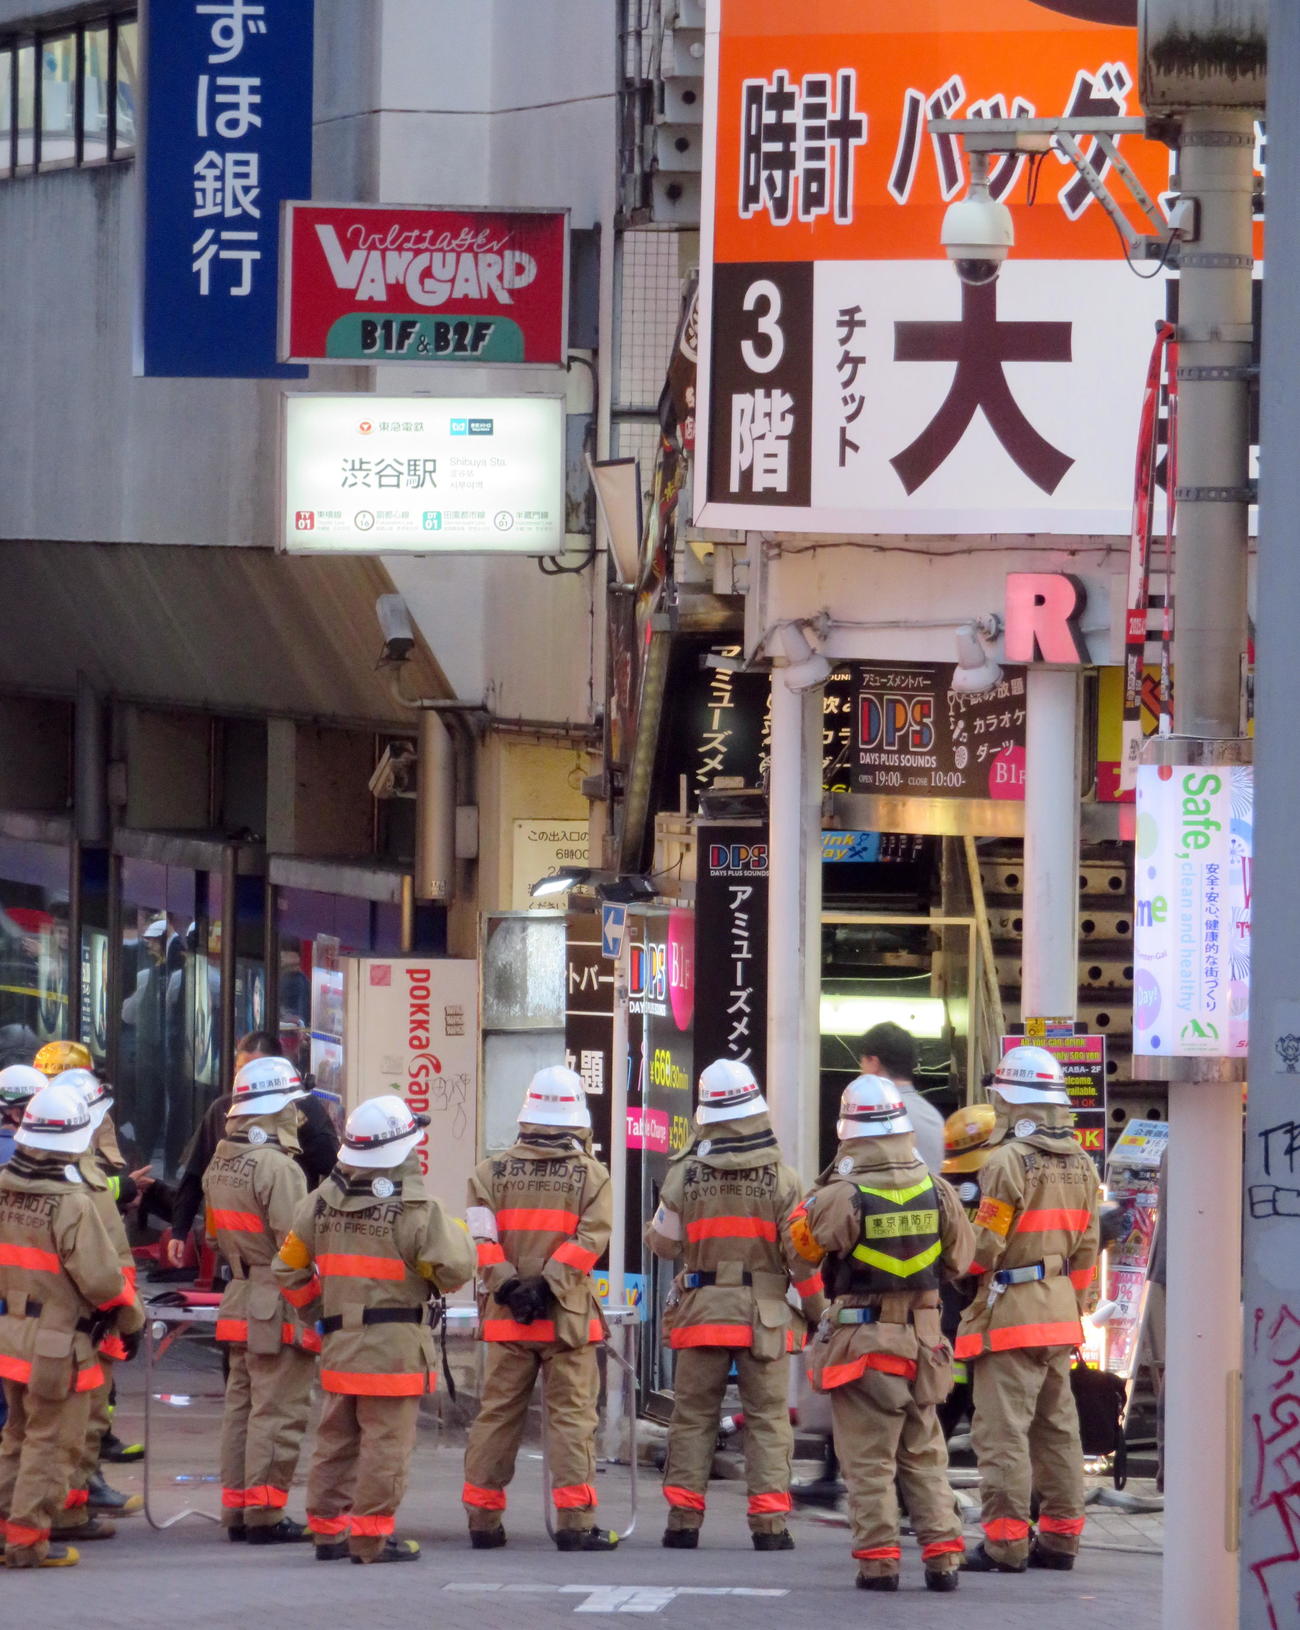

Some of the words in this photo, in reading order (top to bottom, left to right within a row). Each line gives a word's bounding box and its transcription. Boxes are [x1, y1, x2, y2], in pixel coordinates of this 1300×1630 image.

[738, 67, 869, 226] 時計
[361, 320, 421, 354] B1F
[434, 321, 496, 355] B2F
[835, 305, 867, 468] チケット
[889, 278, 1076, 496] 大
[341, 458, 438, 489] 渋谷駅
[299, 520, 312, 530] 01
[425, 520, 439, 530] 01
[1005, 572, 1085, 665] R
[859, 694, 935, 752] DPS
[973, 708, 1026, 735] カラオケ
[859, 752, 880, 766] DAYS
[880, 753, 900, 767] PLUS
[900, 754, 937, 769] SOUNDS
[976, 739, 1015, 763] ダーツ
[405, 968, 431, 1050] pokka
[872, 1213, 934, 1228] 東京消防庁
